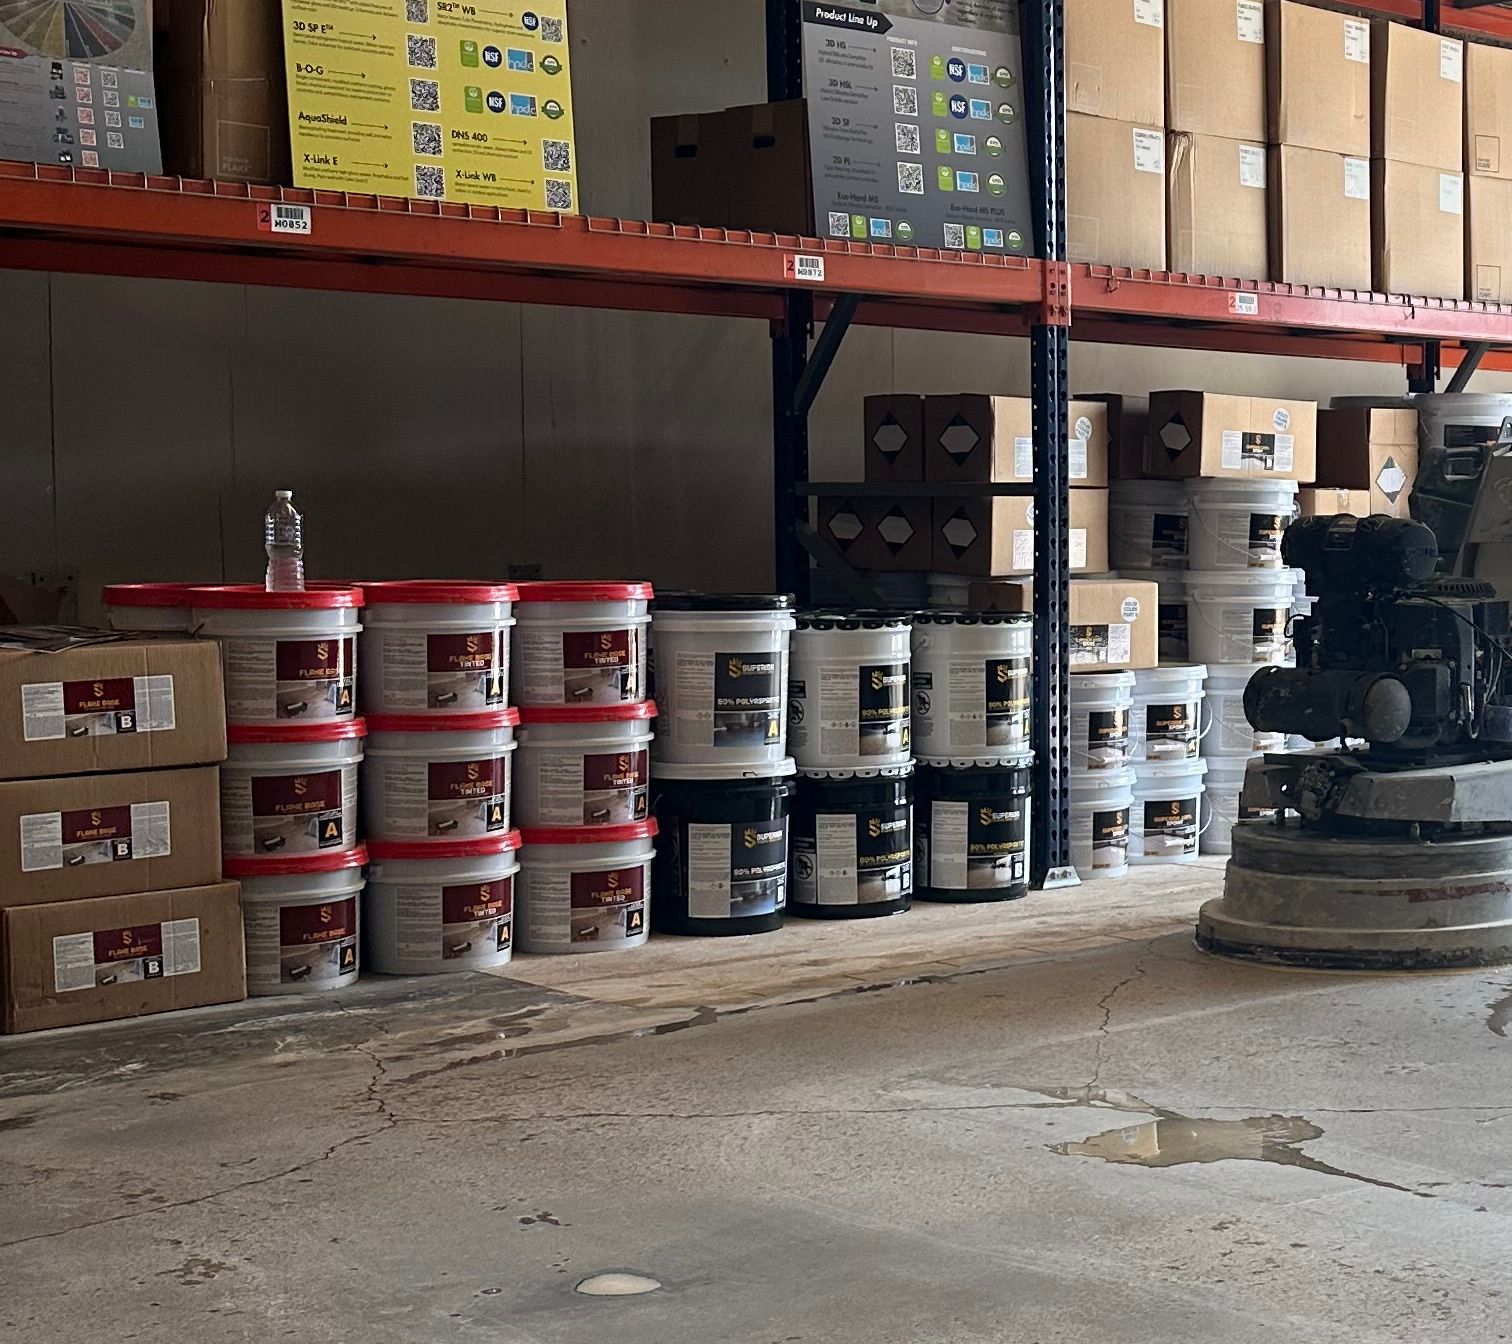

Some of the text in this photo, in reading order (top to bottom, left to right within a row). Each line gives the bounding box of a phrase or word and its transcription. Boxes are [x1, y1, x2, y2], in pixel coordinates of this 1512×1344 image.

[293, 20, 306, 31] 3D
[815, 8, 879, 29] Product Line Up
[296, 63, 324, 75] B-O-G
[451, 129, 488, 142] DNS 400
[303, 153, 338, 165] X-Link E
[260, 209, 269, 224] 2
[787, 260, 795, 271] 2
[339, 689, 350, 706] A
[121, 715, 132, 729] B
[638, 795, 645, 810] A
[492, 806, 502, 822] A
[324, 821, 338, 838] A
[117, 843, 128, 856] B
[631, 911, 641, 928] A
[501, 925, 509, 942] A
[344, 949, 354, 965] A
[149, 961, 160, 974] B
